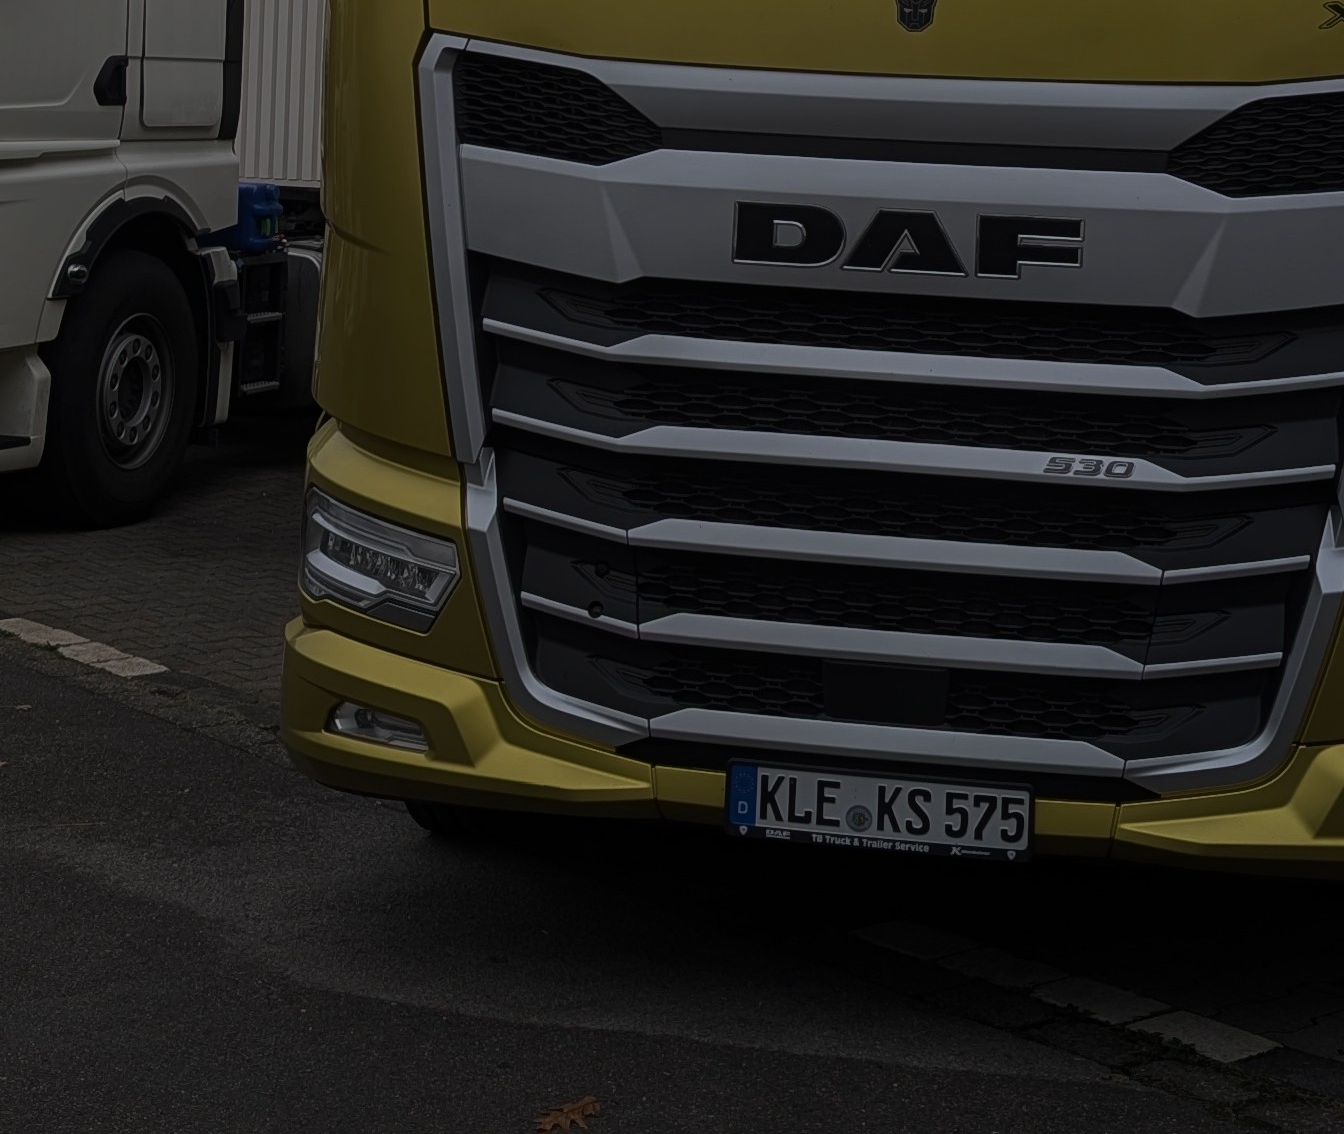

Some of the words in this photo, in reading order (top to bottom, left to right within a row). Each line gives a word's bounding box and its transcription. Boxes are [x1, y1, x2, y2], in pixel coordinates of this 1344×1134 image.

[732, 200, 1086, 280] DAF
[1043, 456, 1135, 479] 530
[737, 800, 749, 815] D
[759, 774, 841, 828] KLE
[876, 784, 933, 836] KS
[944, 791, 1026, 844] 575
[825, 835, 852, 846] Truck
[853, 837, 861, 847] &
[862, 838, 894, 850] Trailer
[894, 840, 931, 853] Service
